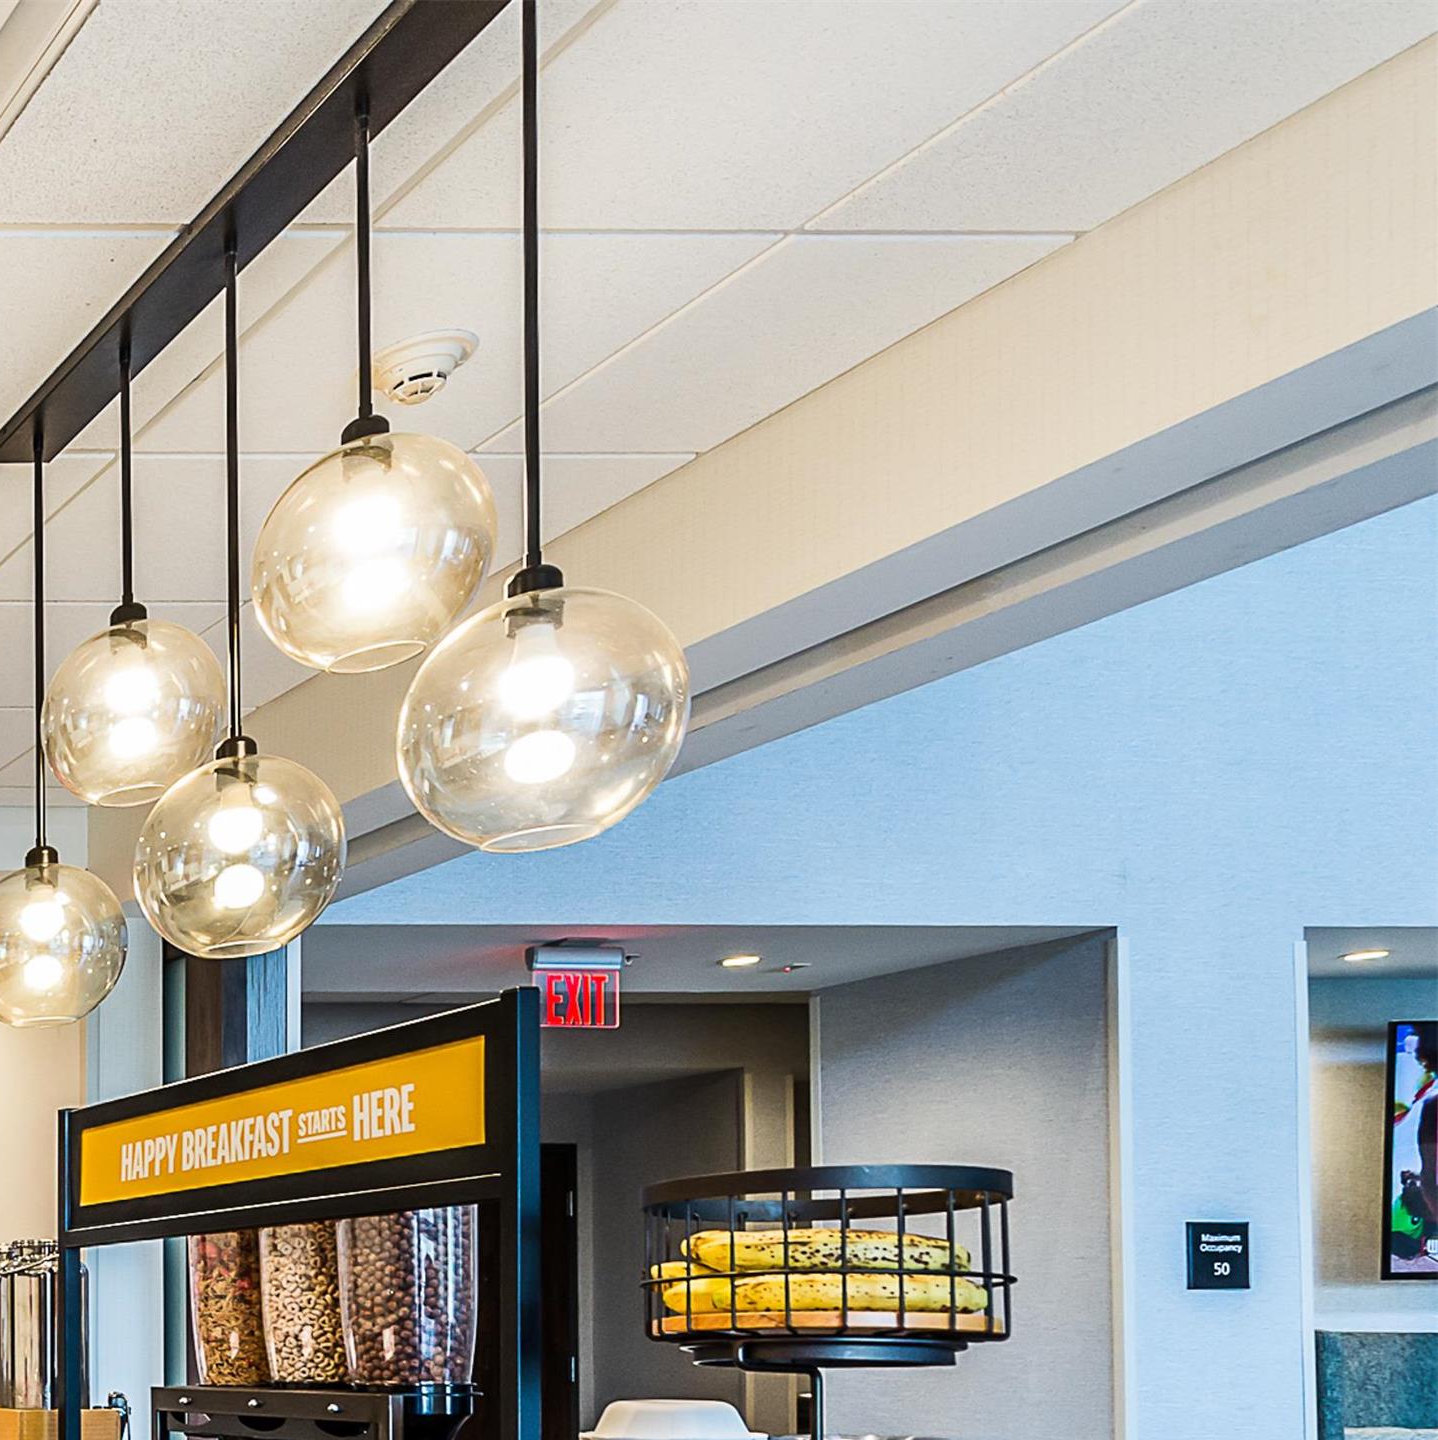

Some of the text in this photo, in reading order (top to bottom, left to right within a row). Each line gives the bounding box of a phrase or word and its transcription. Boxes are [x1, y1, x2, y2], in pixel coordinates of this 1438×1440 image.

[546, 972, 609, 1026] EXIT
[120, 1083, 415, 1182] HAPPY BREAKFAST STARTS HERE
[1200, 1243, 1242, 1254] Occupancy
[1213, 1262, 1230, 1276] 50
